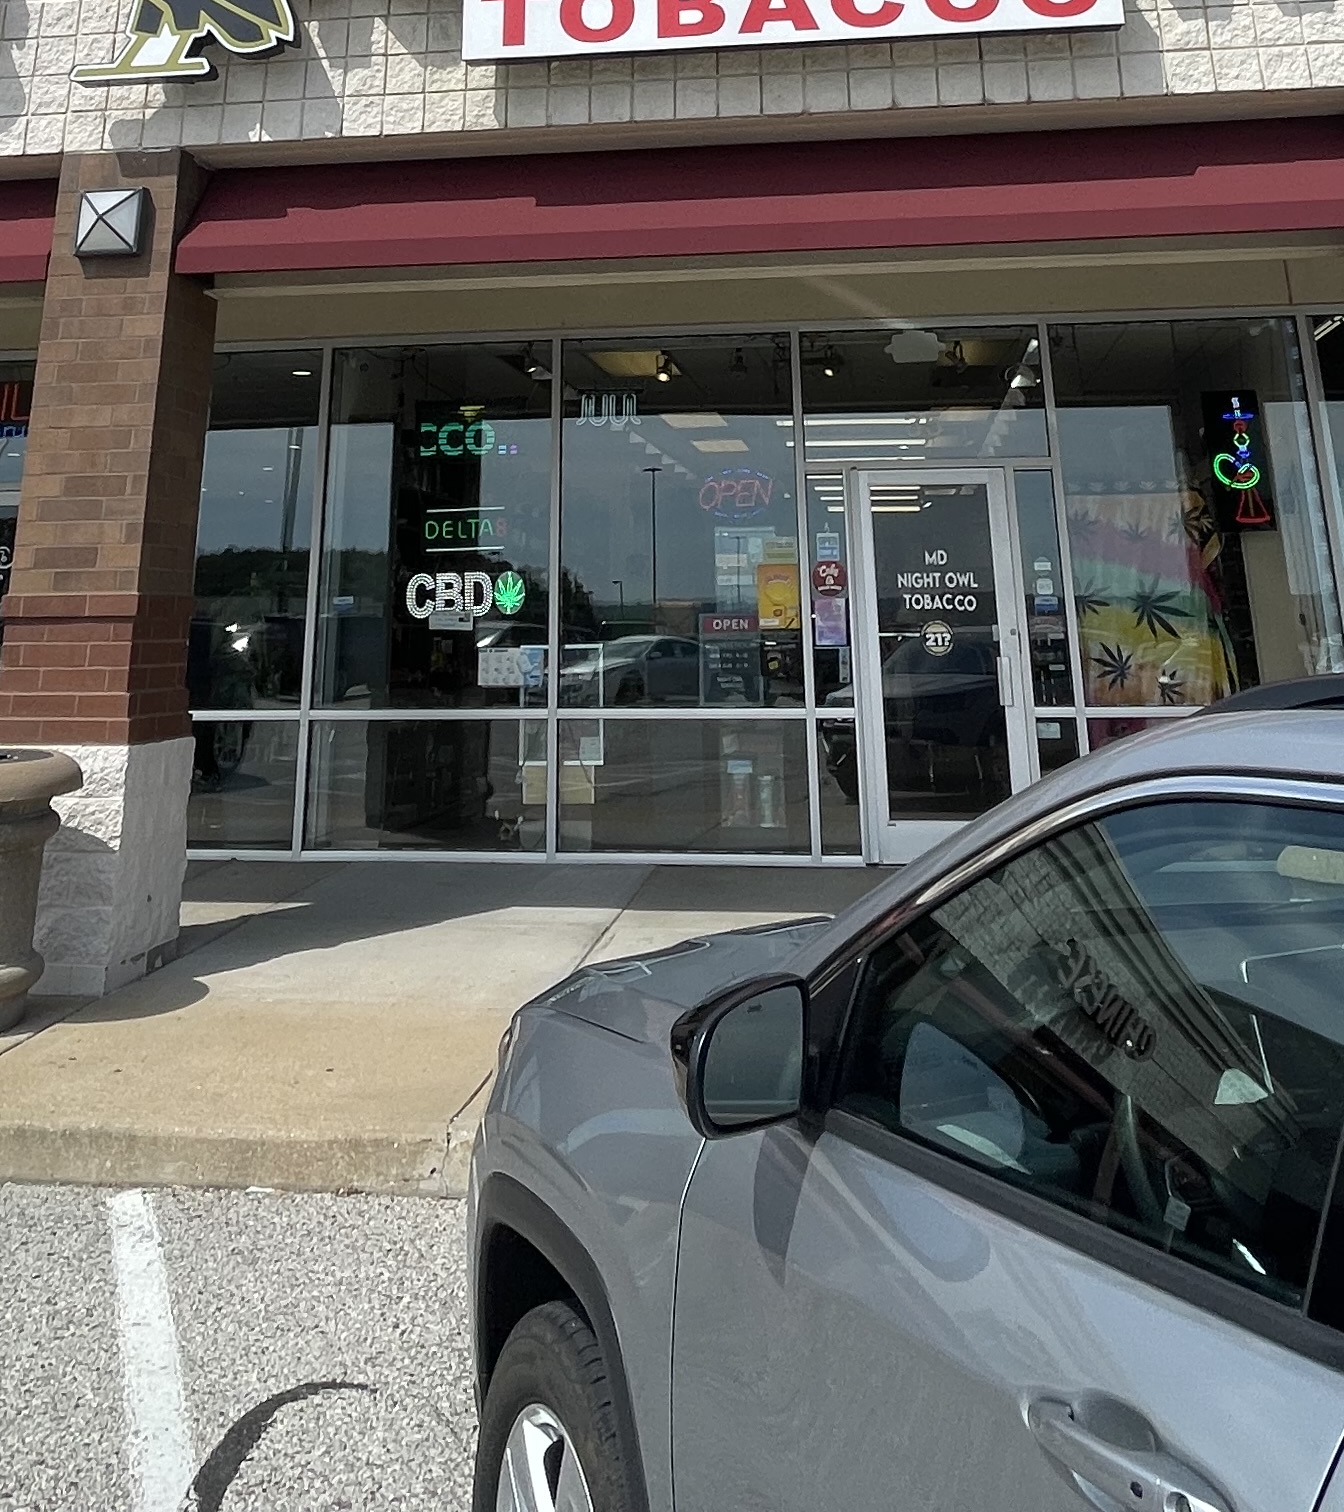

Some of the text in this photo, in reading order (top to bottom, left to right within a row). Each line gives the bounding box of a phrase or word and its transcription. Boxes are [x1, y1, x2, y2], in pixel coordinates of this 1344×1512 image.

[699, 479, 773, 510] OPEN
[924, 549, 948, 566] MD
[897, 571, 979, 589] NIGHT OWL
[405, 571, 494, 619] CBD
[902, 593, 977, 612] TOBACCO
[712, 618, 749, 630] OPEN
[925, 632, 952, 646] 21?
